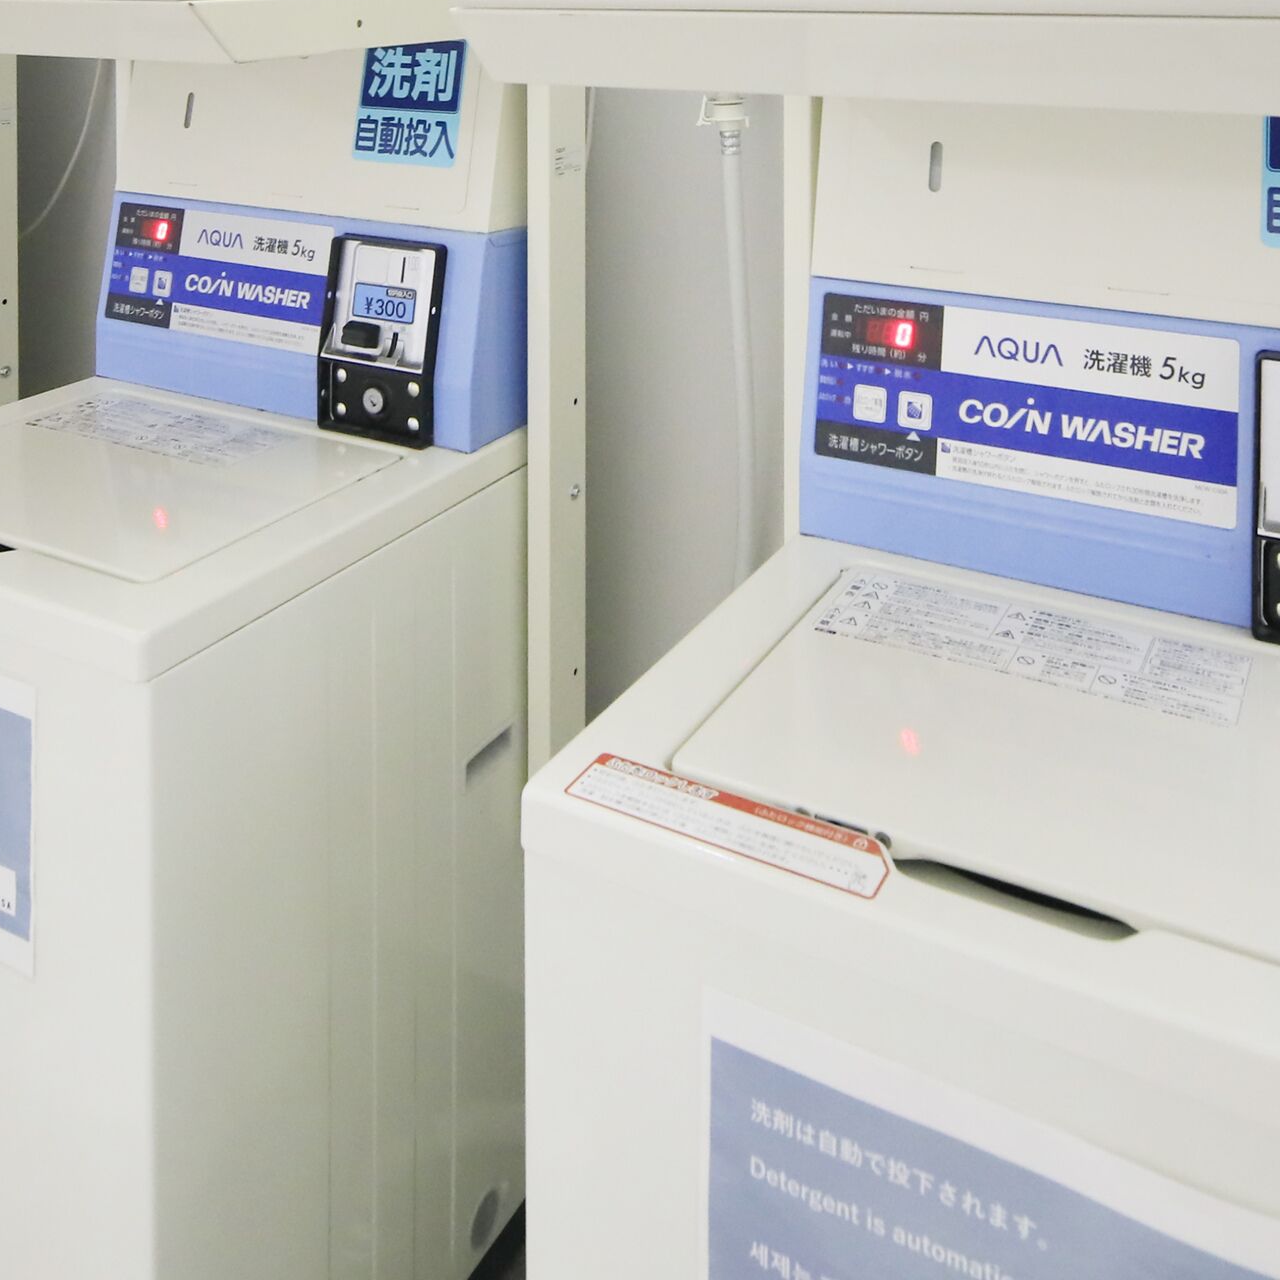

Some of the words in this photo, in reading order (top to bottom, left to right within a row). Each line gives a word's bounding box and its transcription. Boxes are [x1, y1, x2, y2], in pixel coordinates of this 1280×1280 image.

[368, 46, 458, 102] 洗剤
[354, 115, 455, 160] 自動投入
[156, 222, 168, 240] 0
[197, 227, 245, 251] AQUA
[252, 235, 289, 256] 洗濯機
[292, 238, 316, 263] 5kg
[184, 271, 235, 298] COIN
[237, 282, 311, 311] WASHER
[363, 296, 407, 319] ¥300
[854, 303, 915, 320] ただいまの金額
[919, 311, 929, 323] 円
[894, 322, 913, 347] 0
[917, 352, 927, 363] 分
[973, 334, 1064, 368] AQUA
[1083, 348, 1153, 379] 洗濯機
[1158, 356, 1207, 390] 5kg
[827, 432, 924, 463] 洗濯槽シャワーボタン
[957, 397, 1053, 437] COIN
[1061, 413, 1206, 460] WASHER
[749, 1096, 1048, 1251] 洗剤は自動で投下されます。
[749, 1154, 860, 1225] Detergent
[866, 1207, 886, 1237] is
